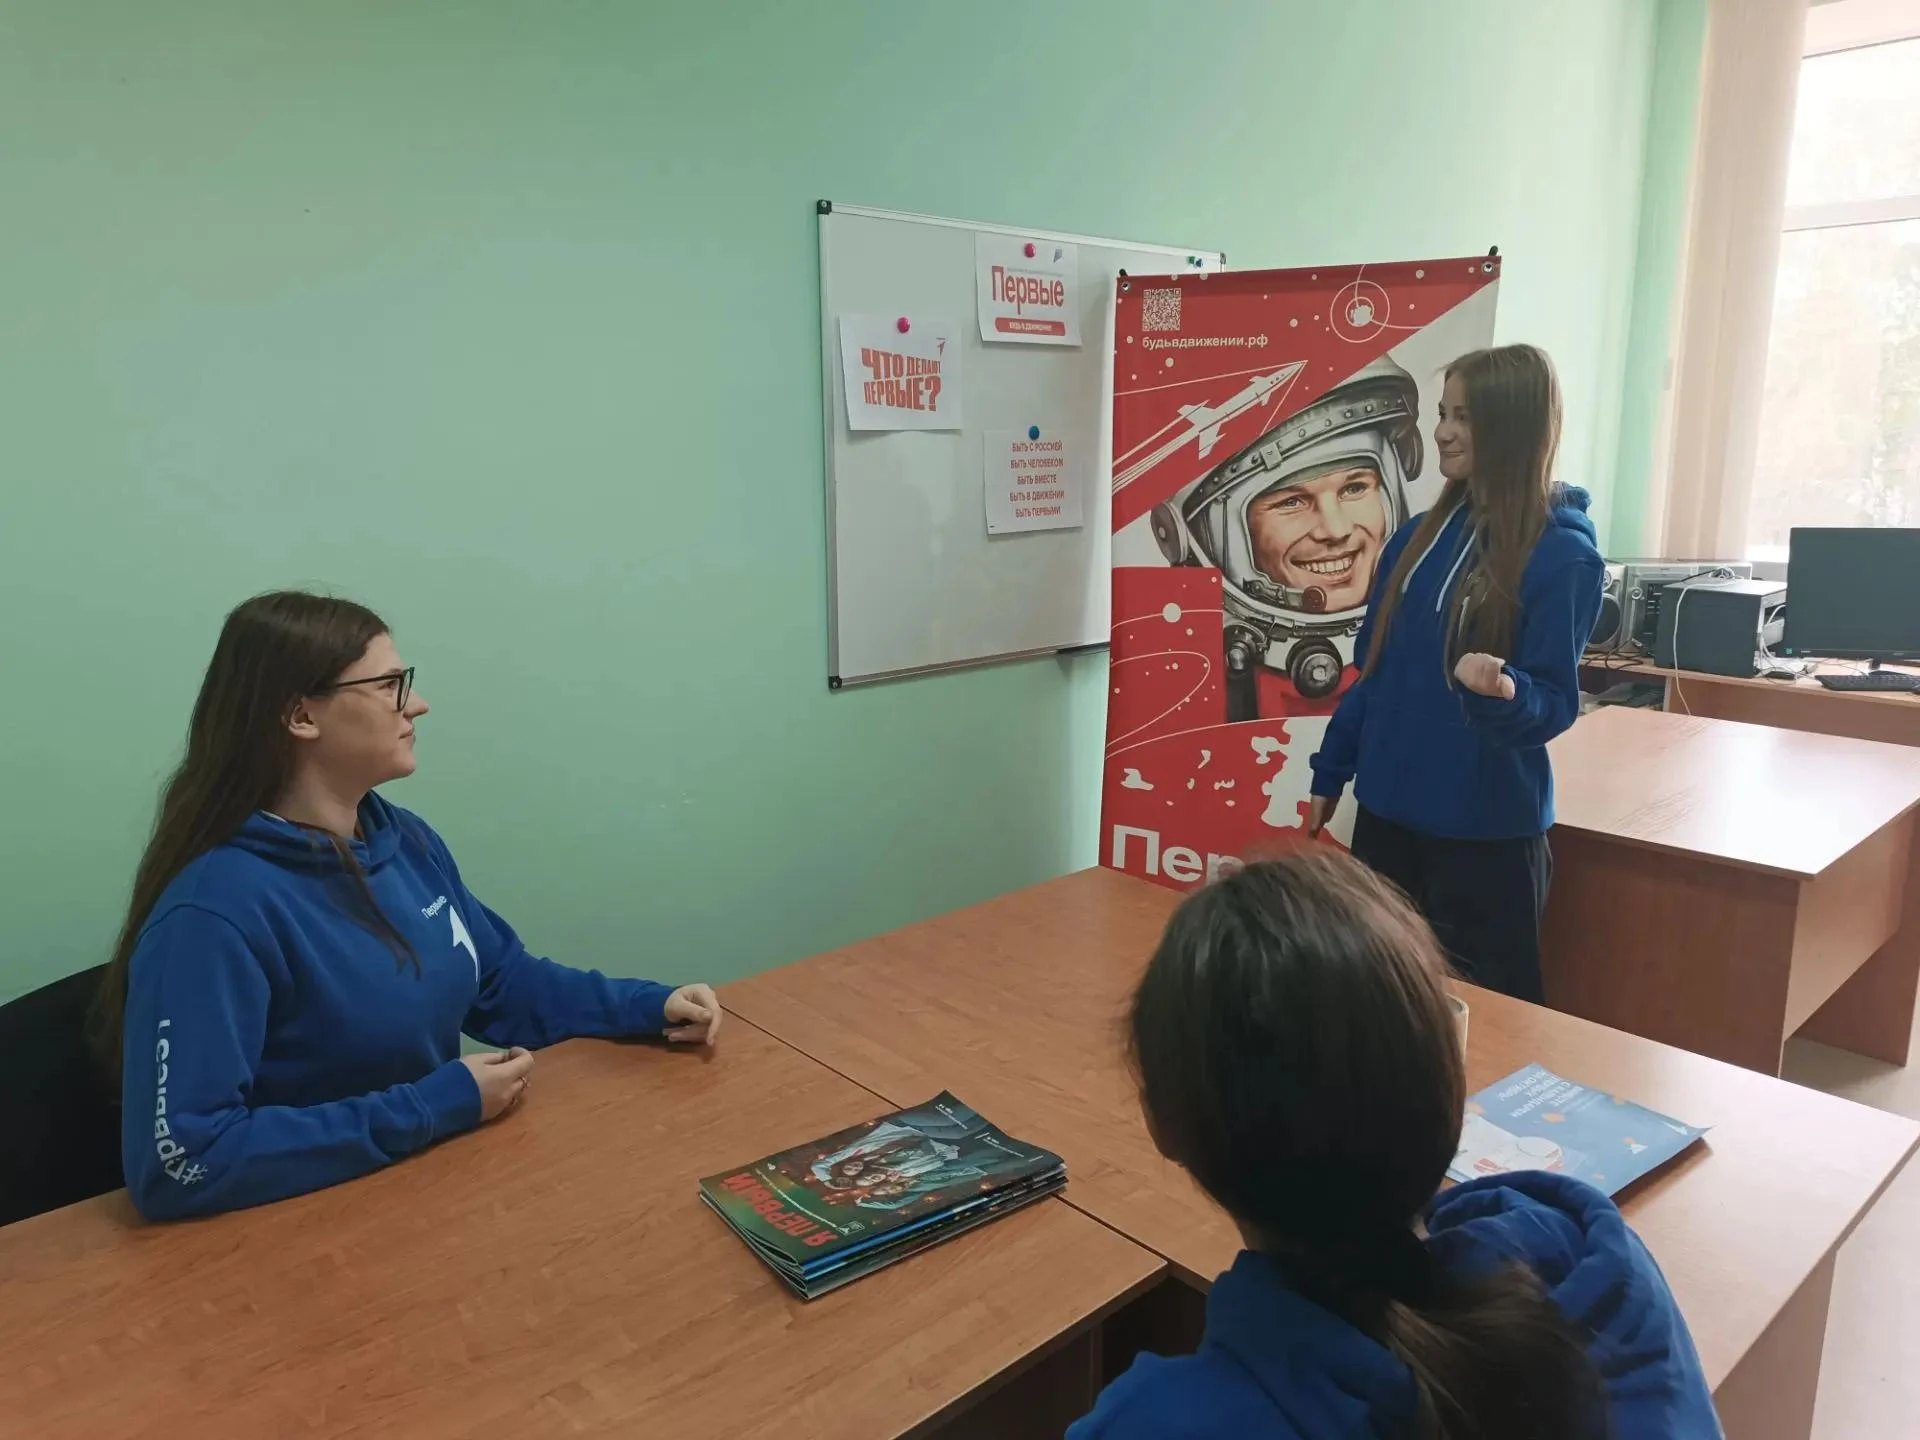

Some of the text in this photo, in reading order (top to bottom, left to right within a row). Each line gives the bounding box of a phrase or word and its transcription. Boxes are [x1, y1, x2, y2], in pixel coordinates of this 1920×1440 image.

[991, 265, 1065, 315] Первые
[1141, 333, 1270, 350] будьвдвижении.рф
[861, 347, 904, 380] ЧТО
[863, 375, 942, 412] ПЕРВЫЕ?
[1012, 440, 1063, 452] БЫТЬ С РОССИЕЙ
[1010, 458, 1064, 469] БЫТЬ ЧЕЛОВЕКОМ
[1017, 474, 1056, 485] БЫТЬ ВМЕСТЕ
[1010, 490, 1064, 502] БЫТЬ В ДВИЖЕНИИ
[1016, 506, 1061, 518] БЫТЬ ПЕРВЫМИ
[1112, 824, 1245, 885] Пер
[719, 1172, 820, 1237] ПЕРВЫЙ
[803, 1230, 838, 1247] Я
